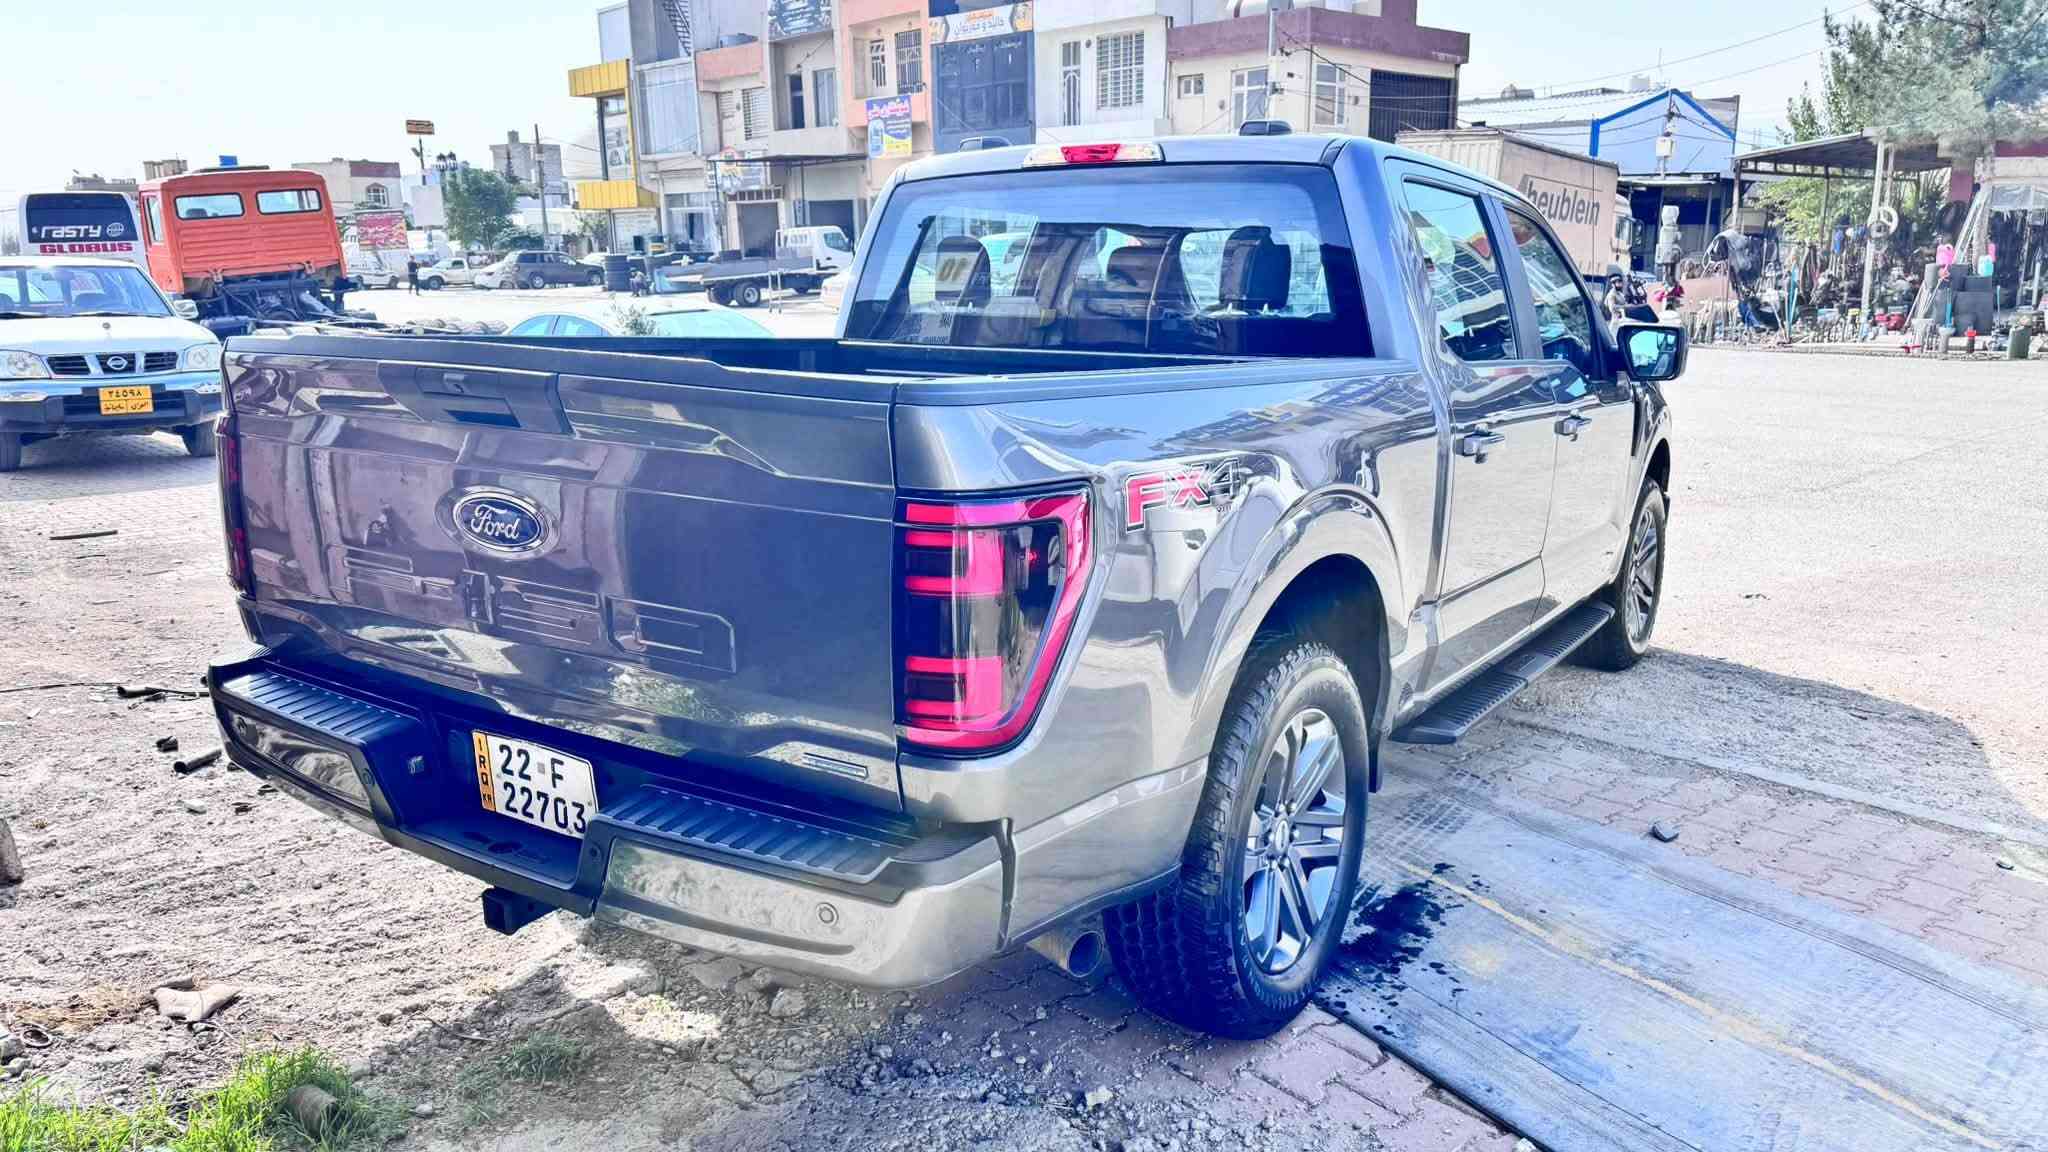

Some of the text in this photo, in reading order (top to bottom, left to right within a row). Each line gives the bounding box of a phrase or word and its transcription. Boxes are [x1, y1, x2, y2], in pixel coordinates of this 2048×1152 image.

[1527, 180, 1600, 226] heublein
[40, 243, 133, 253] GLOBUS
[1125, 457, 1241, 533] FX4
[470, 503, 521, 539] Ford
[499, 744, 564, 789] 22 F
[503, 781, 587, 834] 22703
